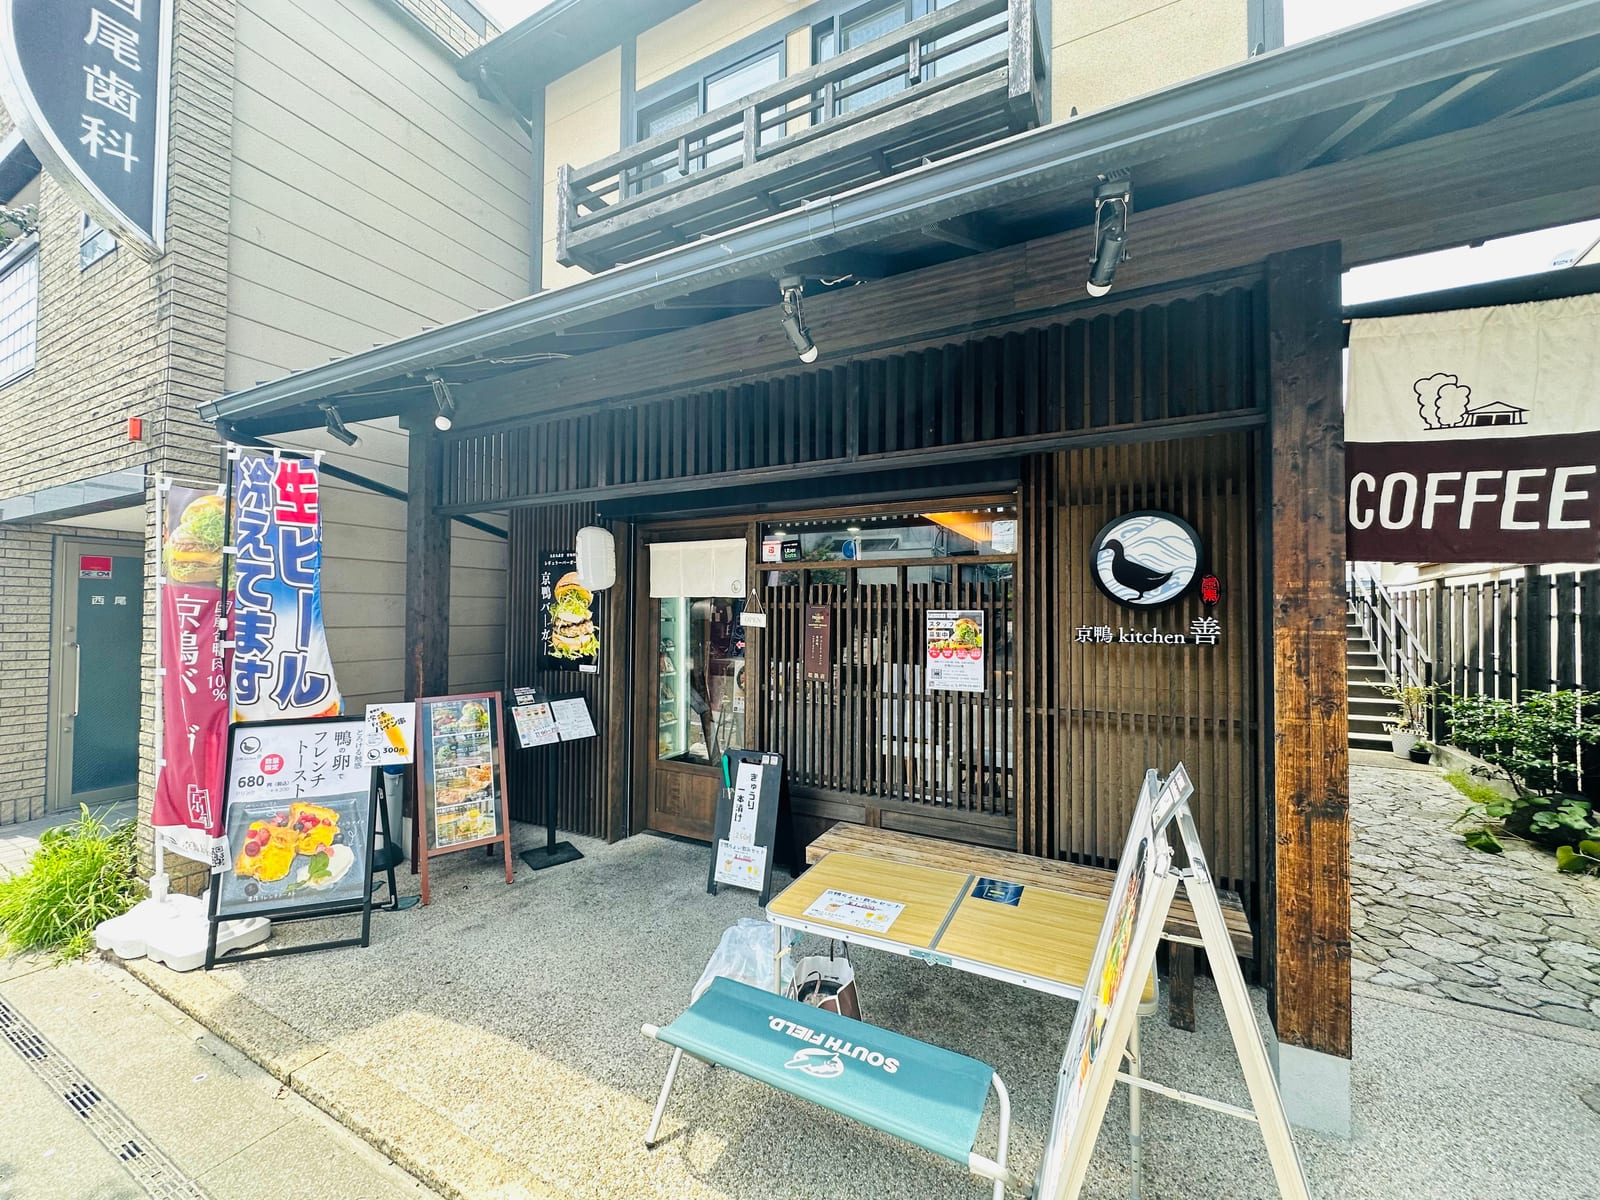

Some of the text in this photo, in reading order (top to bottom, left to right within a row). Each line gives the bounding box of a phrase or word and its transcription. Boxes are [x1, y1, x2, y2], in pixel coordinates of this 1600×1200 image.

[1349, 465, 1597, 530] COFFEE
[1074, 616, 1221, 645] 京鴨 kitchen 善
[292, 740, 308, 799] トースト
[310, 731, 328, 788] フレンチ
[332, 729, 352, 780] 鴨の卵で
[824, 1038, 901, 1074] SOUTH
